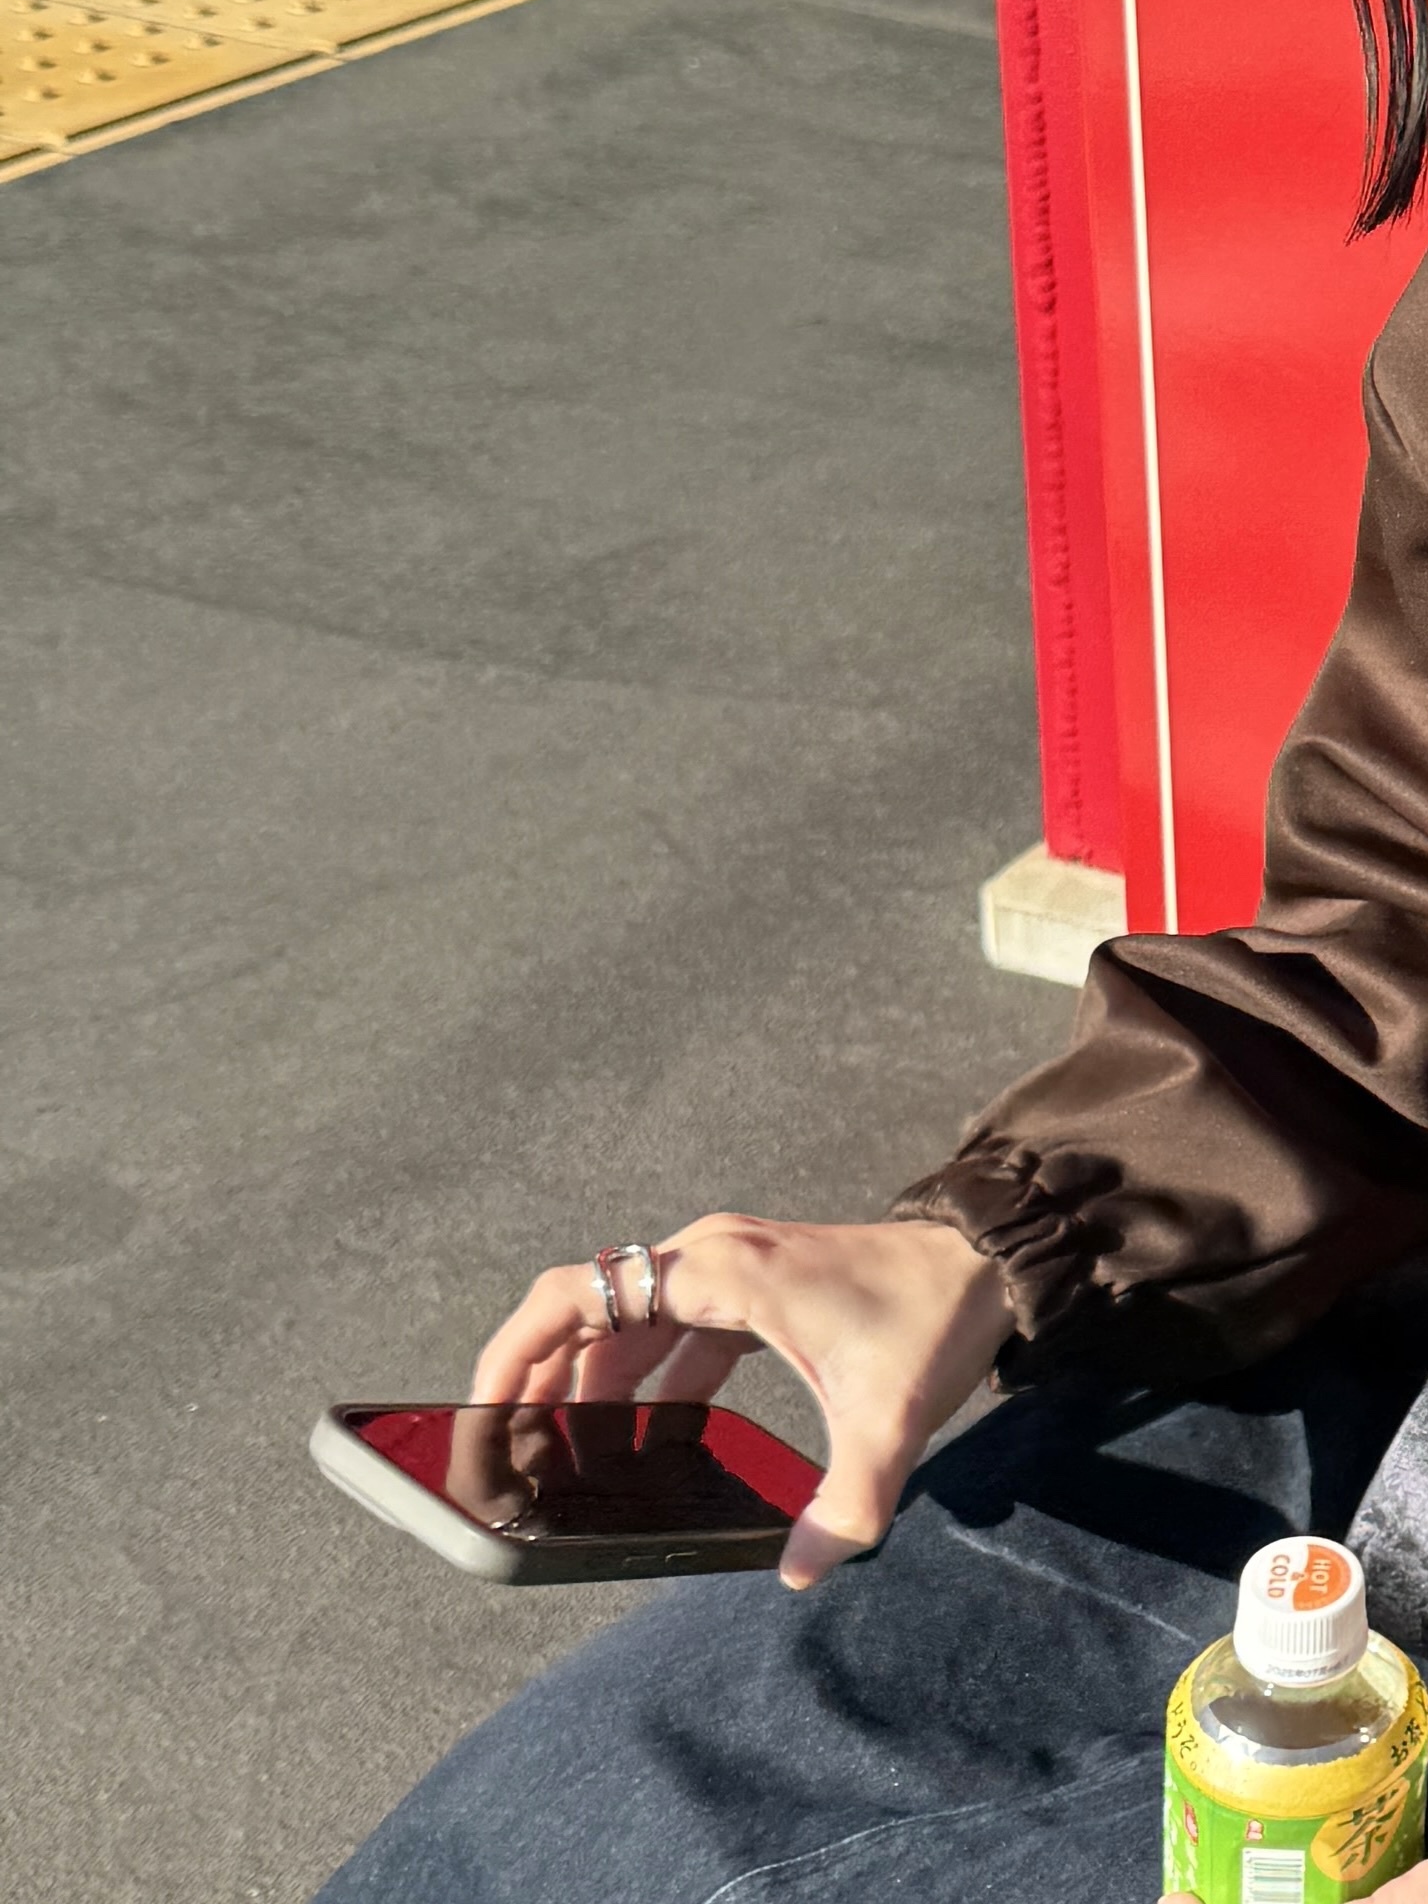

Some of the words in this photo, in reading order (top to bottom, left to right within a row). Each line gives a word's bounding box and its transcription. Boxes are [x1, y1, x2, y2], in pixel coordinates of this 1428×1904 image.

[1267, 1553, 1290, 1599] COLD
[1309, 1558, 1332, 1594] HOT
[1329, 1787, 1400, 1873] 茶
